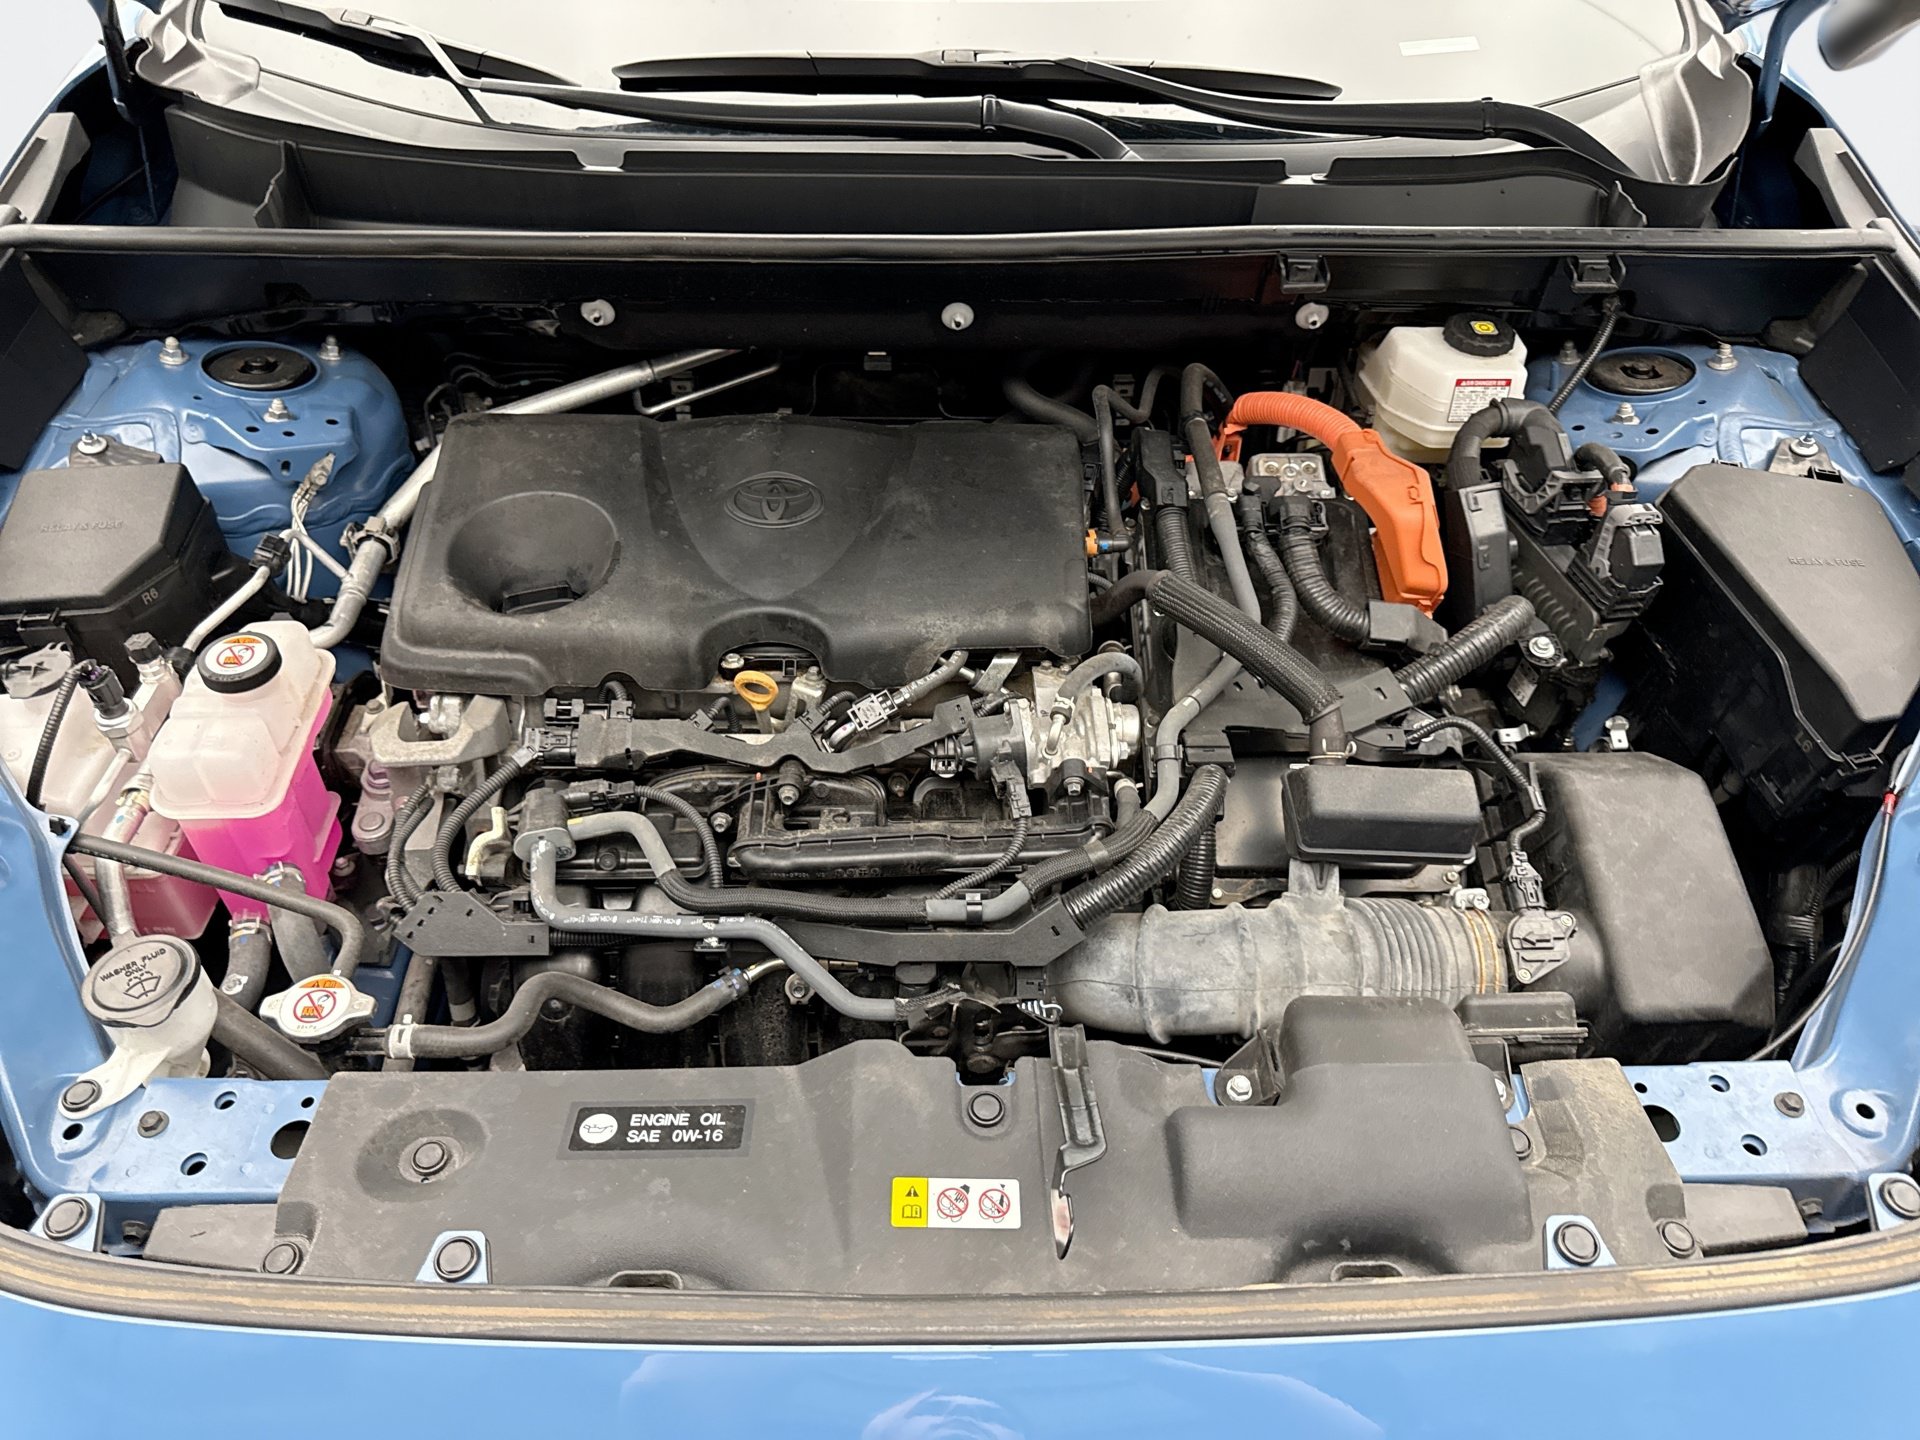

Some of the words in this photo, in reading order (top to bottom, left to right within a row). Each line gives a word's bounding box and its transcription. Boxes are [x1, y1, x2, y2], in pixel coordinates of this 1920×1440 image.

[40, 521, 79, 534] RELAY
[91, 519, 124, 531] FUSE
[1787, 557, 1823, 566] RELAY
[1834, 558, 1865, 568] FUSE
[141, 587, 159, 605] R6
[1794, 730, 1813, 753] L6
[100, 960, 138, 982] WASHER
[141, 947, 166, 963] FLUID
[124, 962, 147, 978] ONLY
[629, 1113, 690, 1127] ENGINE
[699, 1112, 726, 1126] OIL
[626, 1129, 661, 1143] SAE
[671, 1129, 724, 1143] 0W-16
